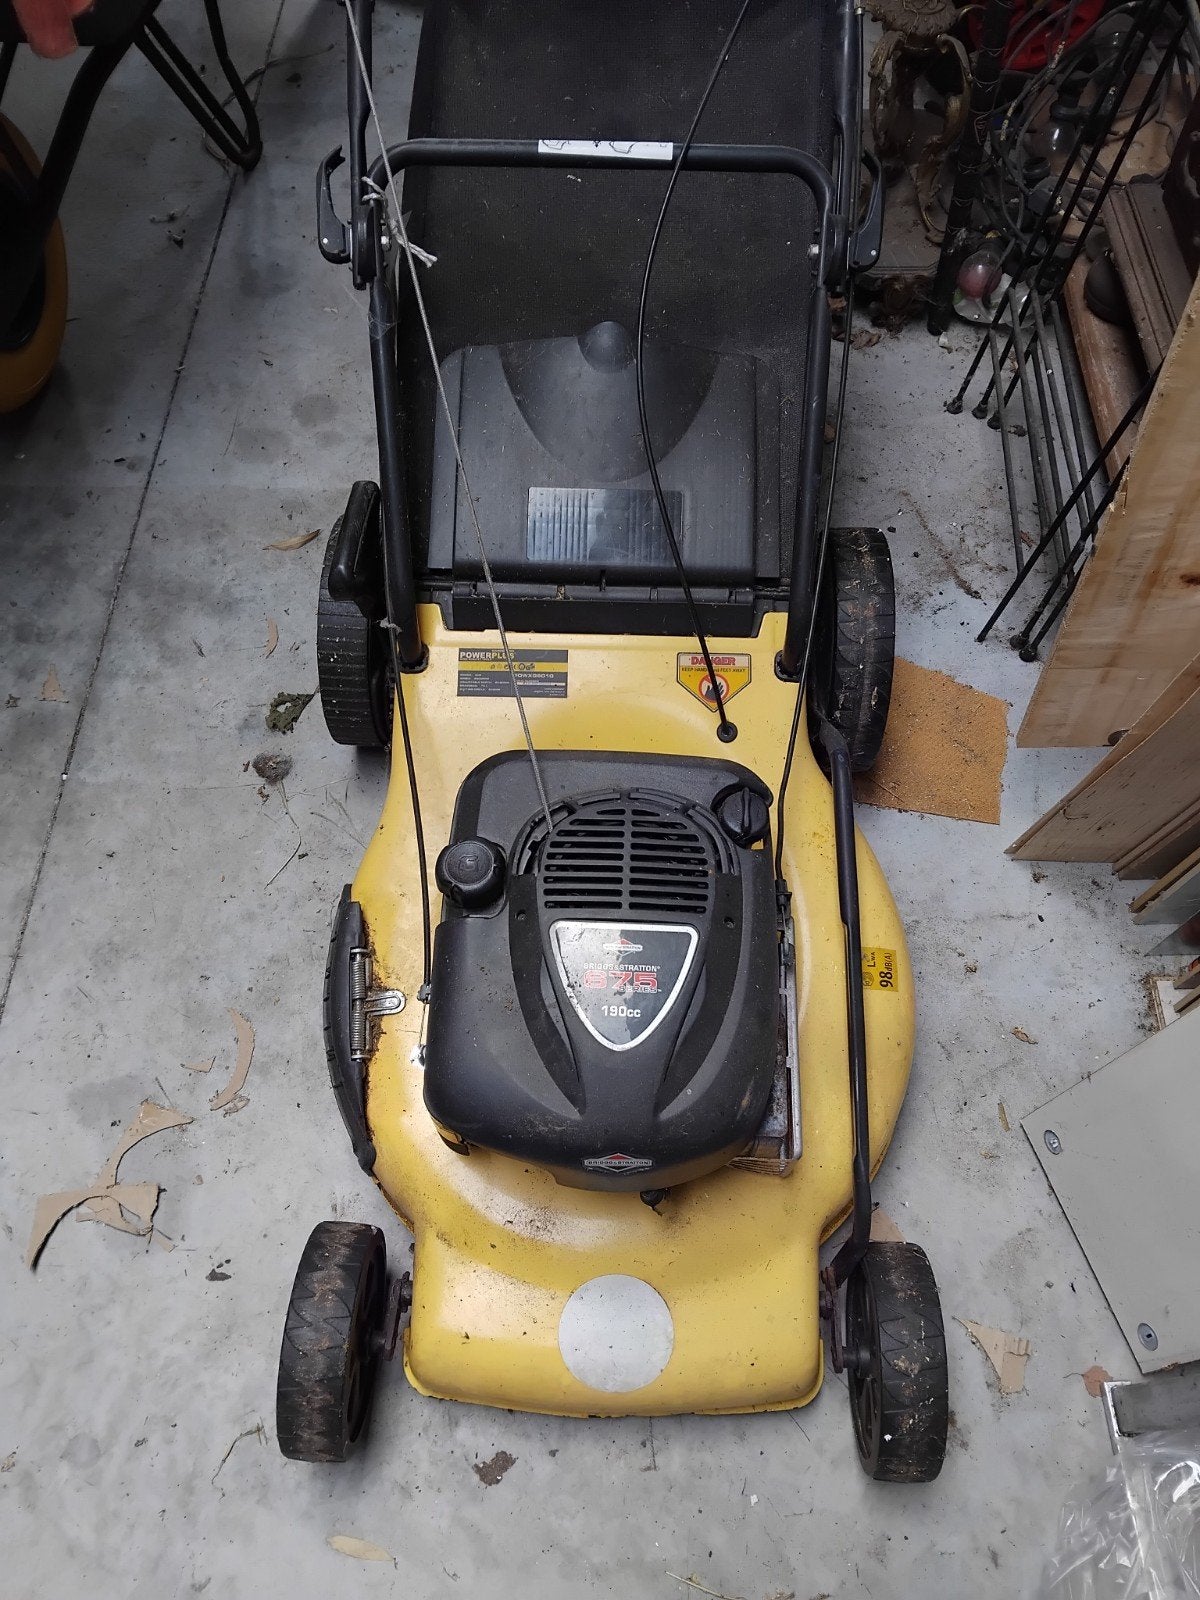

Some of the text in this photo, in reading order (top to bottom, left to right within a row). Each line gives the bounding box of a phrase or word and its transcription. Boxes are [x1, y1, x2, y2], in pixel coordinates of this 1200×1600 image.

[690, 656, 736, 666] DAGER
[584, 970, 658, 990] 675
[602, 1006, 641, 1018] 190cc
